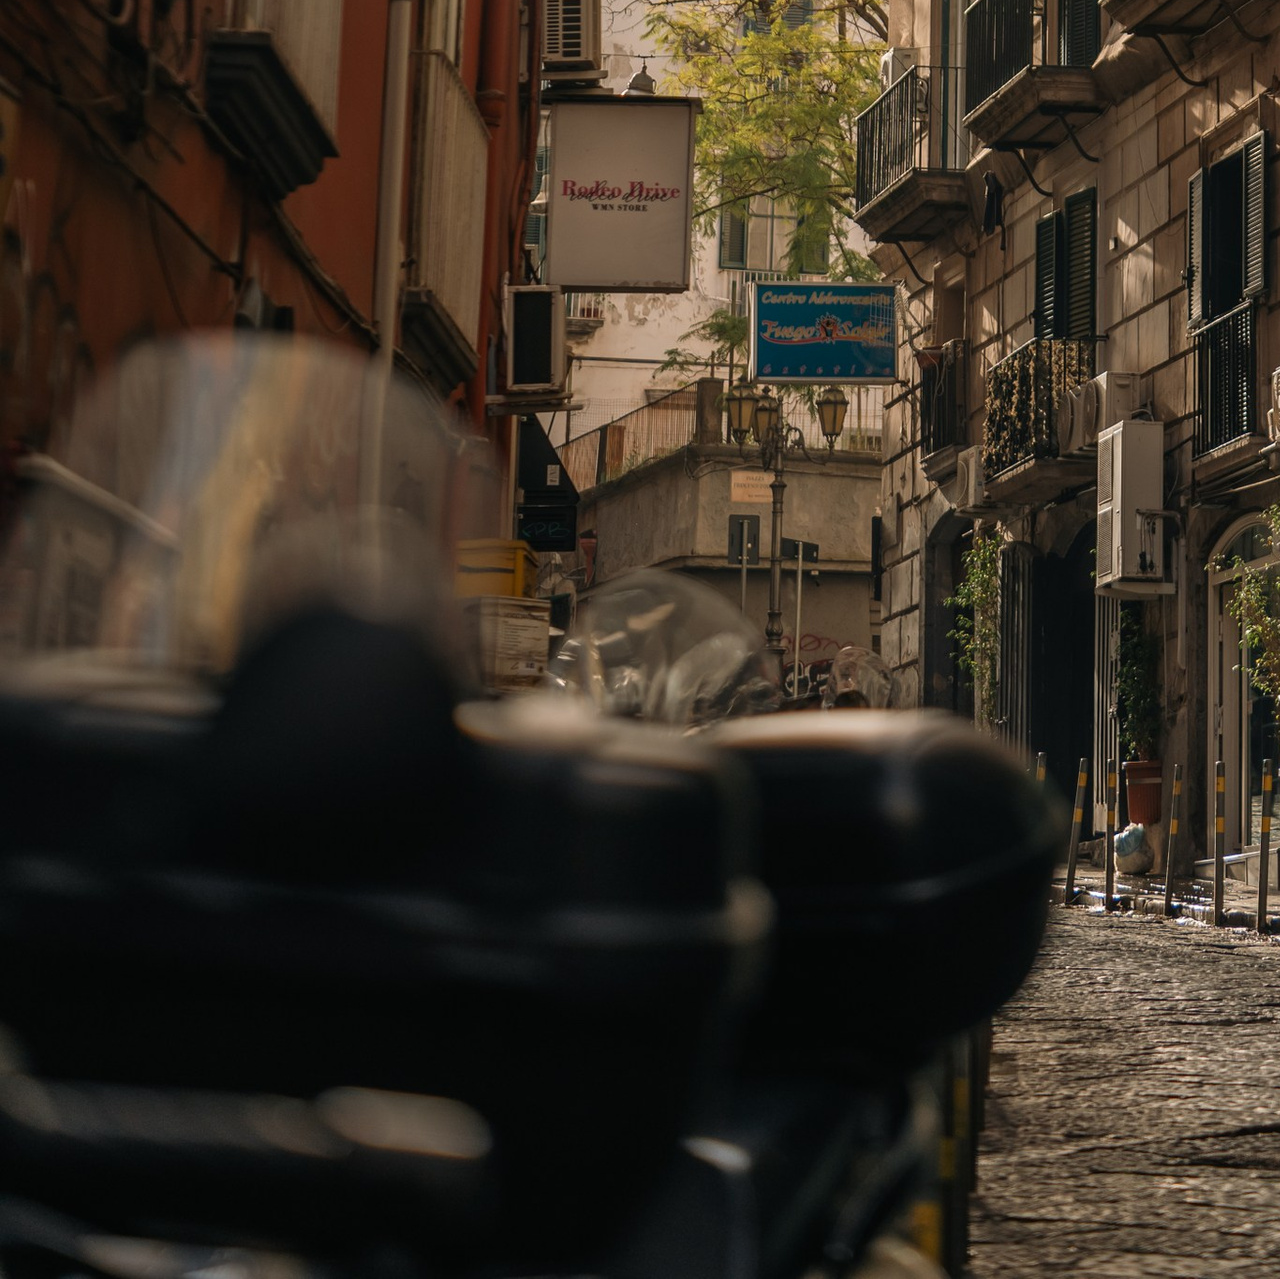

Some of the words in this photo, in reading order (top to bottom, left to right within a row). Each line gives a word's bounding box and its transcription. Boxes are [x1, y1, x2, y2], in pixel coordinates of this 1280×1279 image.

[561, 179, 622, 198] Rodeo
[628, 181, 681, 199] Drive
[592, 203, 615, 211] WMN
[617, 204, 649, 212] STORE
[761, 290, 807, 304] Centro
[761, 319, 815, 342] Fuego
